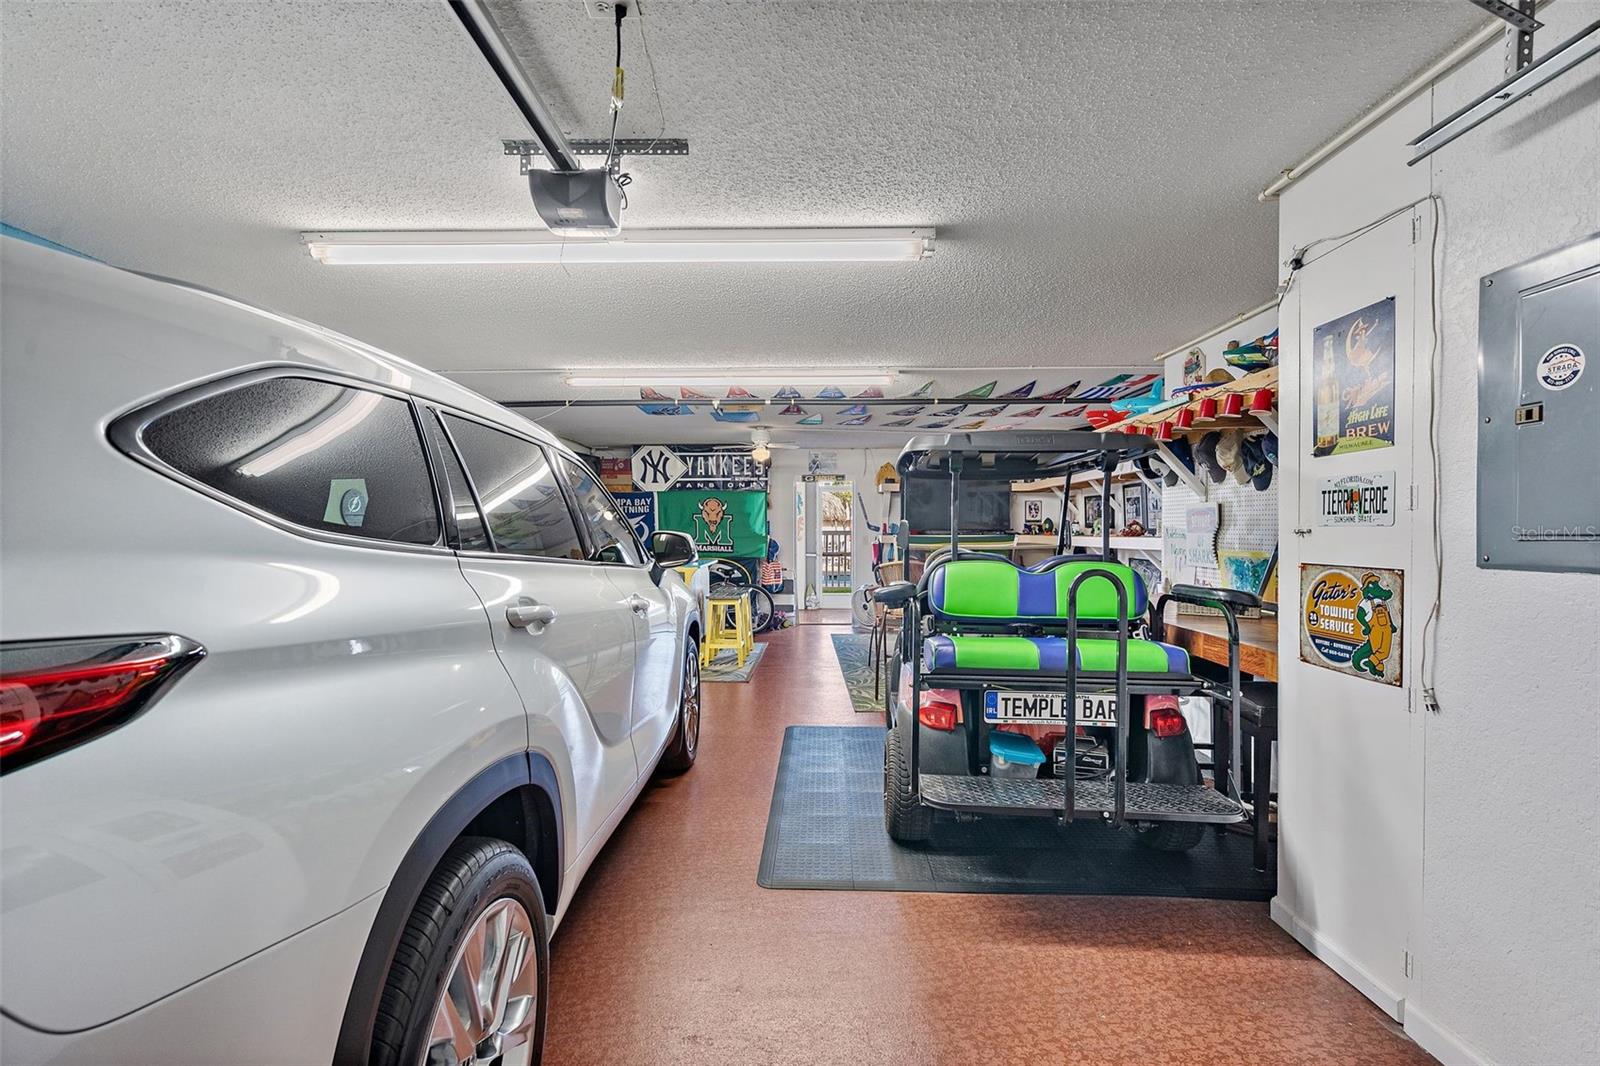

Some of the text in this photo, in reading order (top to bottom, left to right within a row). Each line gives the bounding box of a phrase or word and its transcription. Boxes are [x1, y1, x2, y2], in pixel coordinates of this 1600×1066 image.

[1547, 362, 1579, 373] STRADA
[1345, 420, 1390, 440] BREW
[686, 455, 764, 476] YANKEES
[614, 497, 652, 507] MPA BAY
[1321, 486, 1389, 515] TIERRA VERDE
[1334, 515, 1373, 523] SUNSHINE STATE
[695, 545, 734, 553] MARSHALL
[1312, 580, 1358, 608] Gator's
[1319, 604, 1355, 620] TOWING
[1319, 618, 1355, 635] SERVICE
[1082, 699, 1118, 720] BAR
